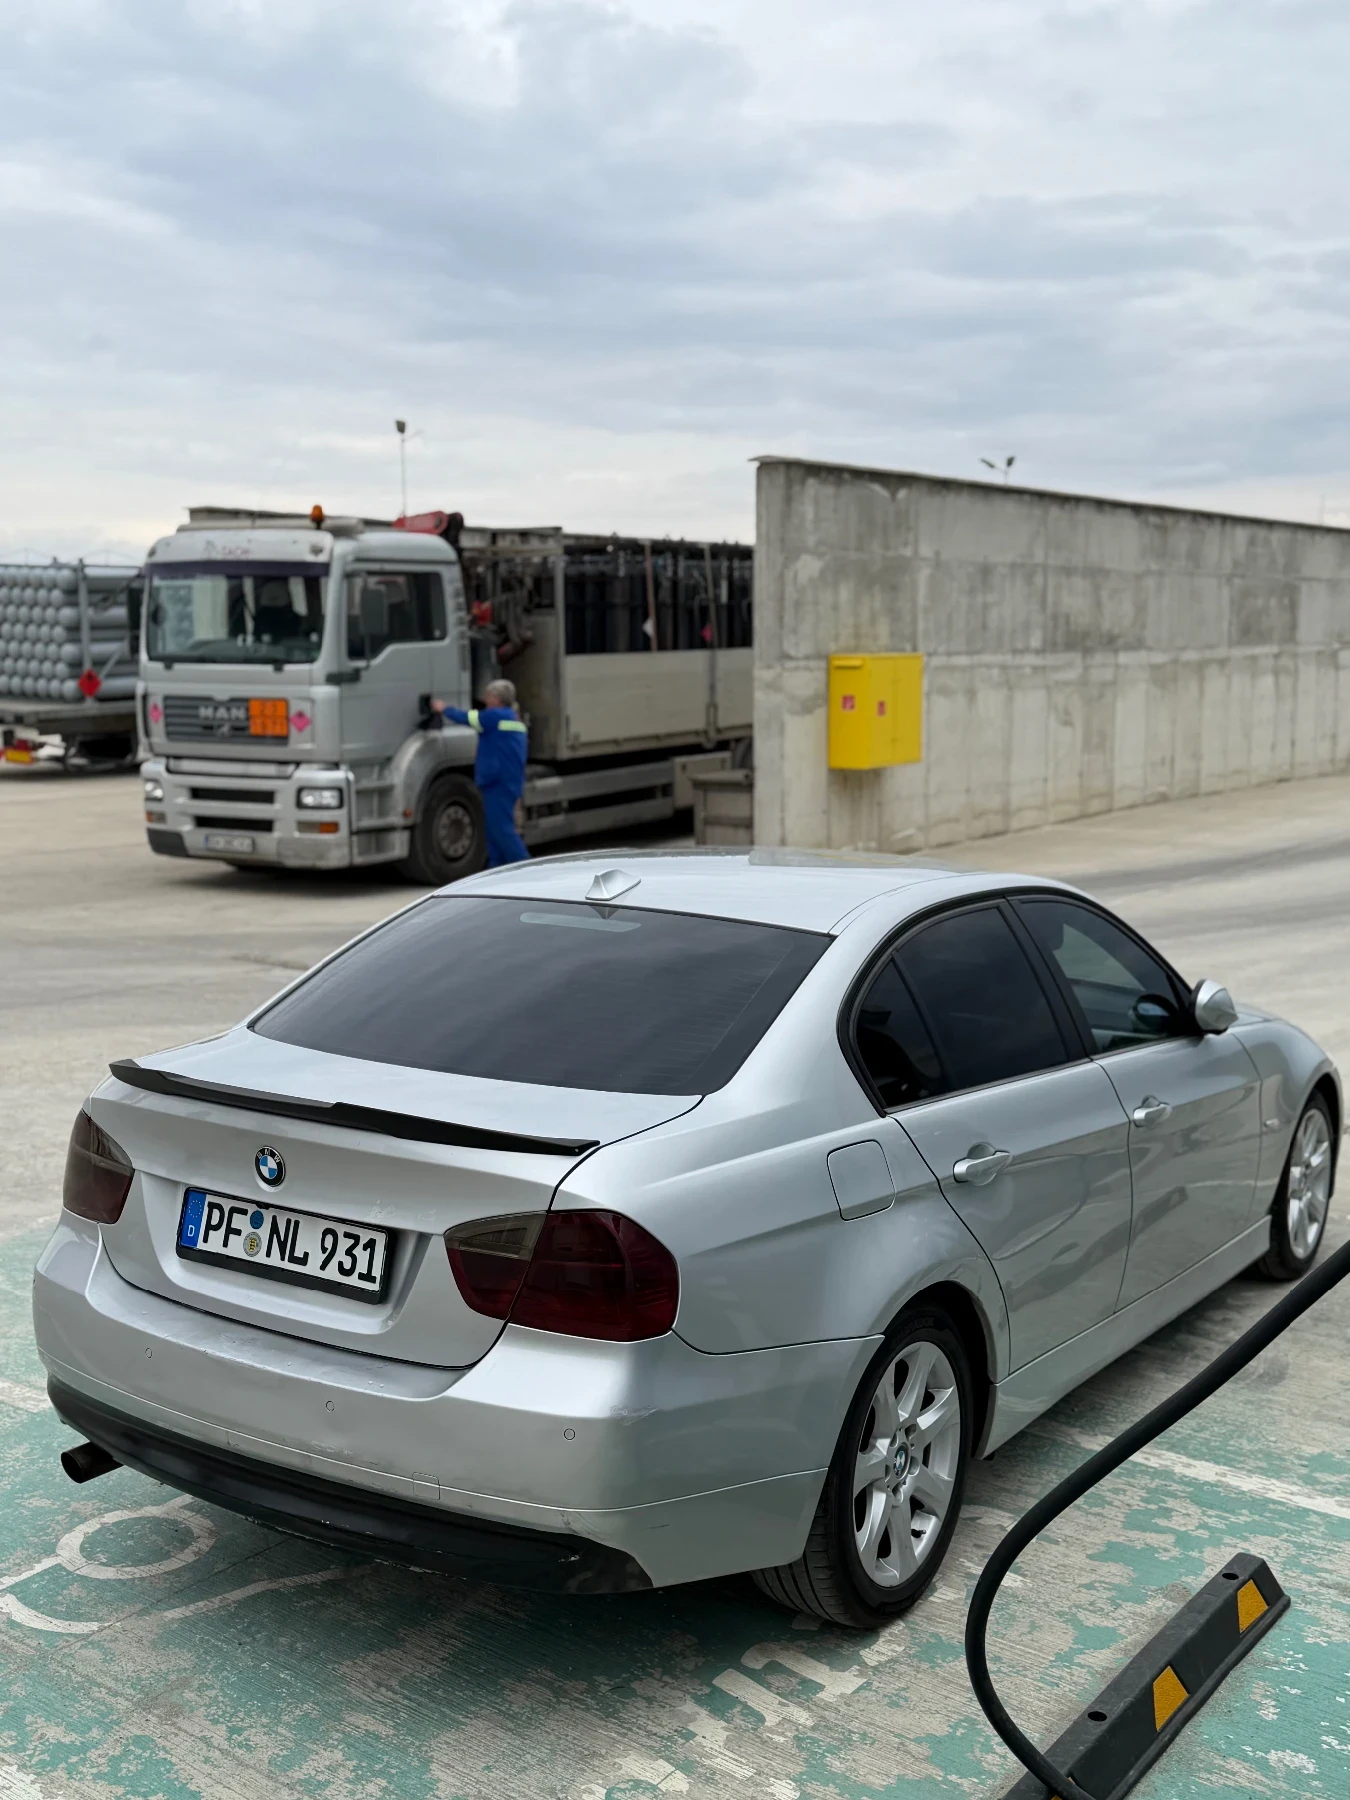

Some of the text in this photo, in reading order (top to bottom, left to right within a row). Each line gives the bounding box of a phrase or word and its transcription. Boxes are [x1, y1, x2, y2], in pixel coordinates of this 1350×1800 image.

[199, 705, 246, 720] MAN
[257, 1149, 280, 1163] BMW
[187, 1225, 195, 1237] D
[202, 1201, 249, 1248] PF
[265, 1215, 310, 1267] NL
[319, 1227, 378, 1284] 931
